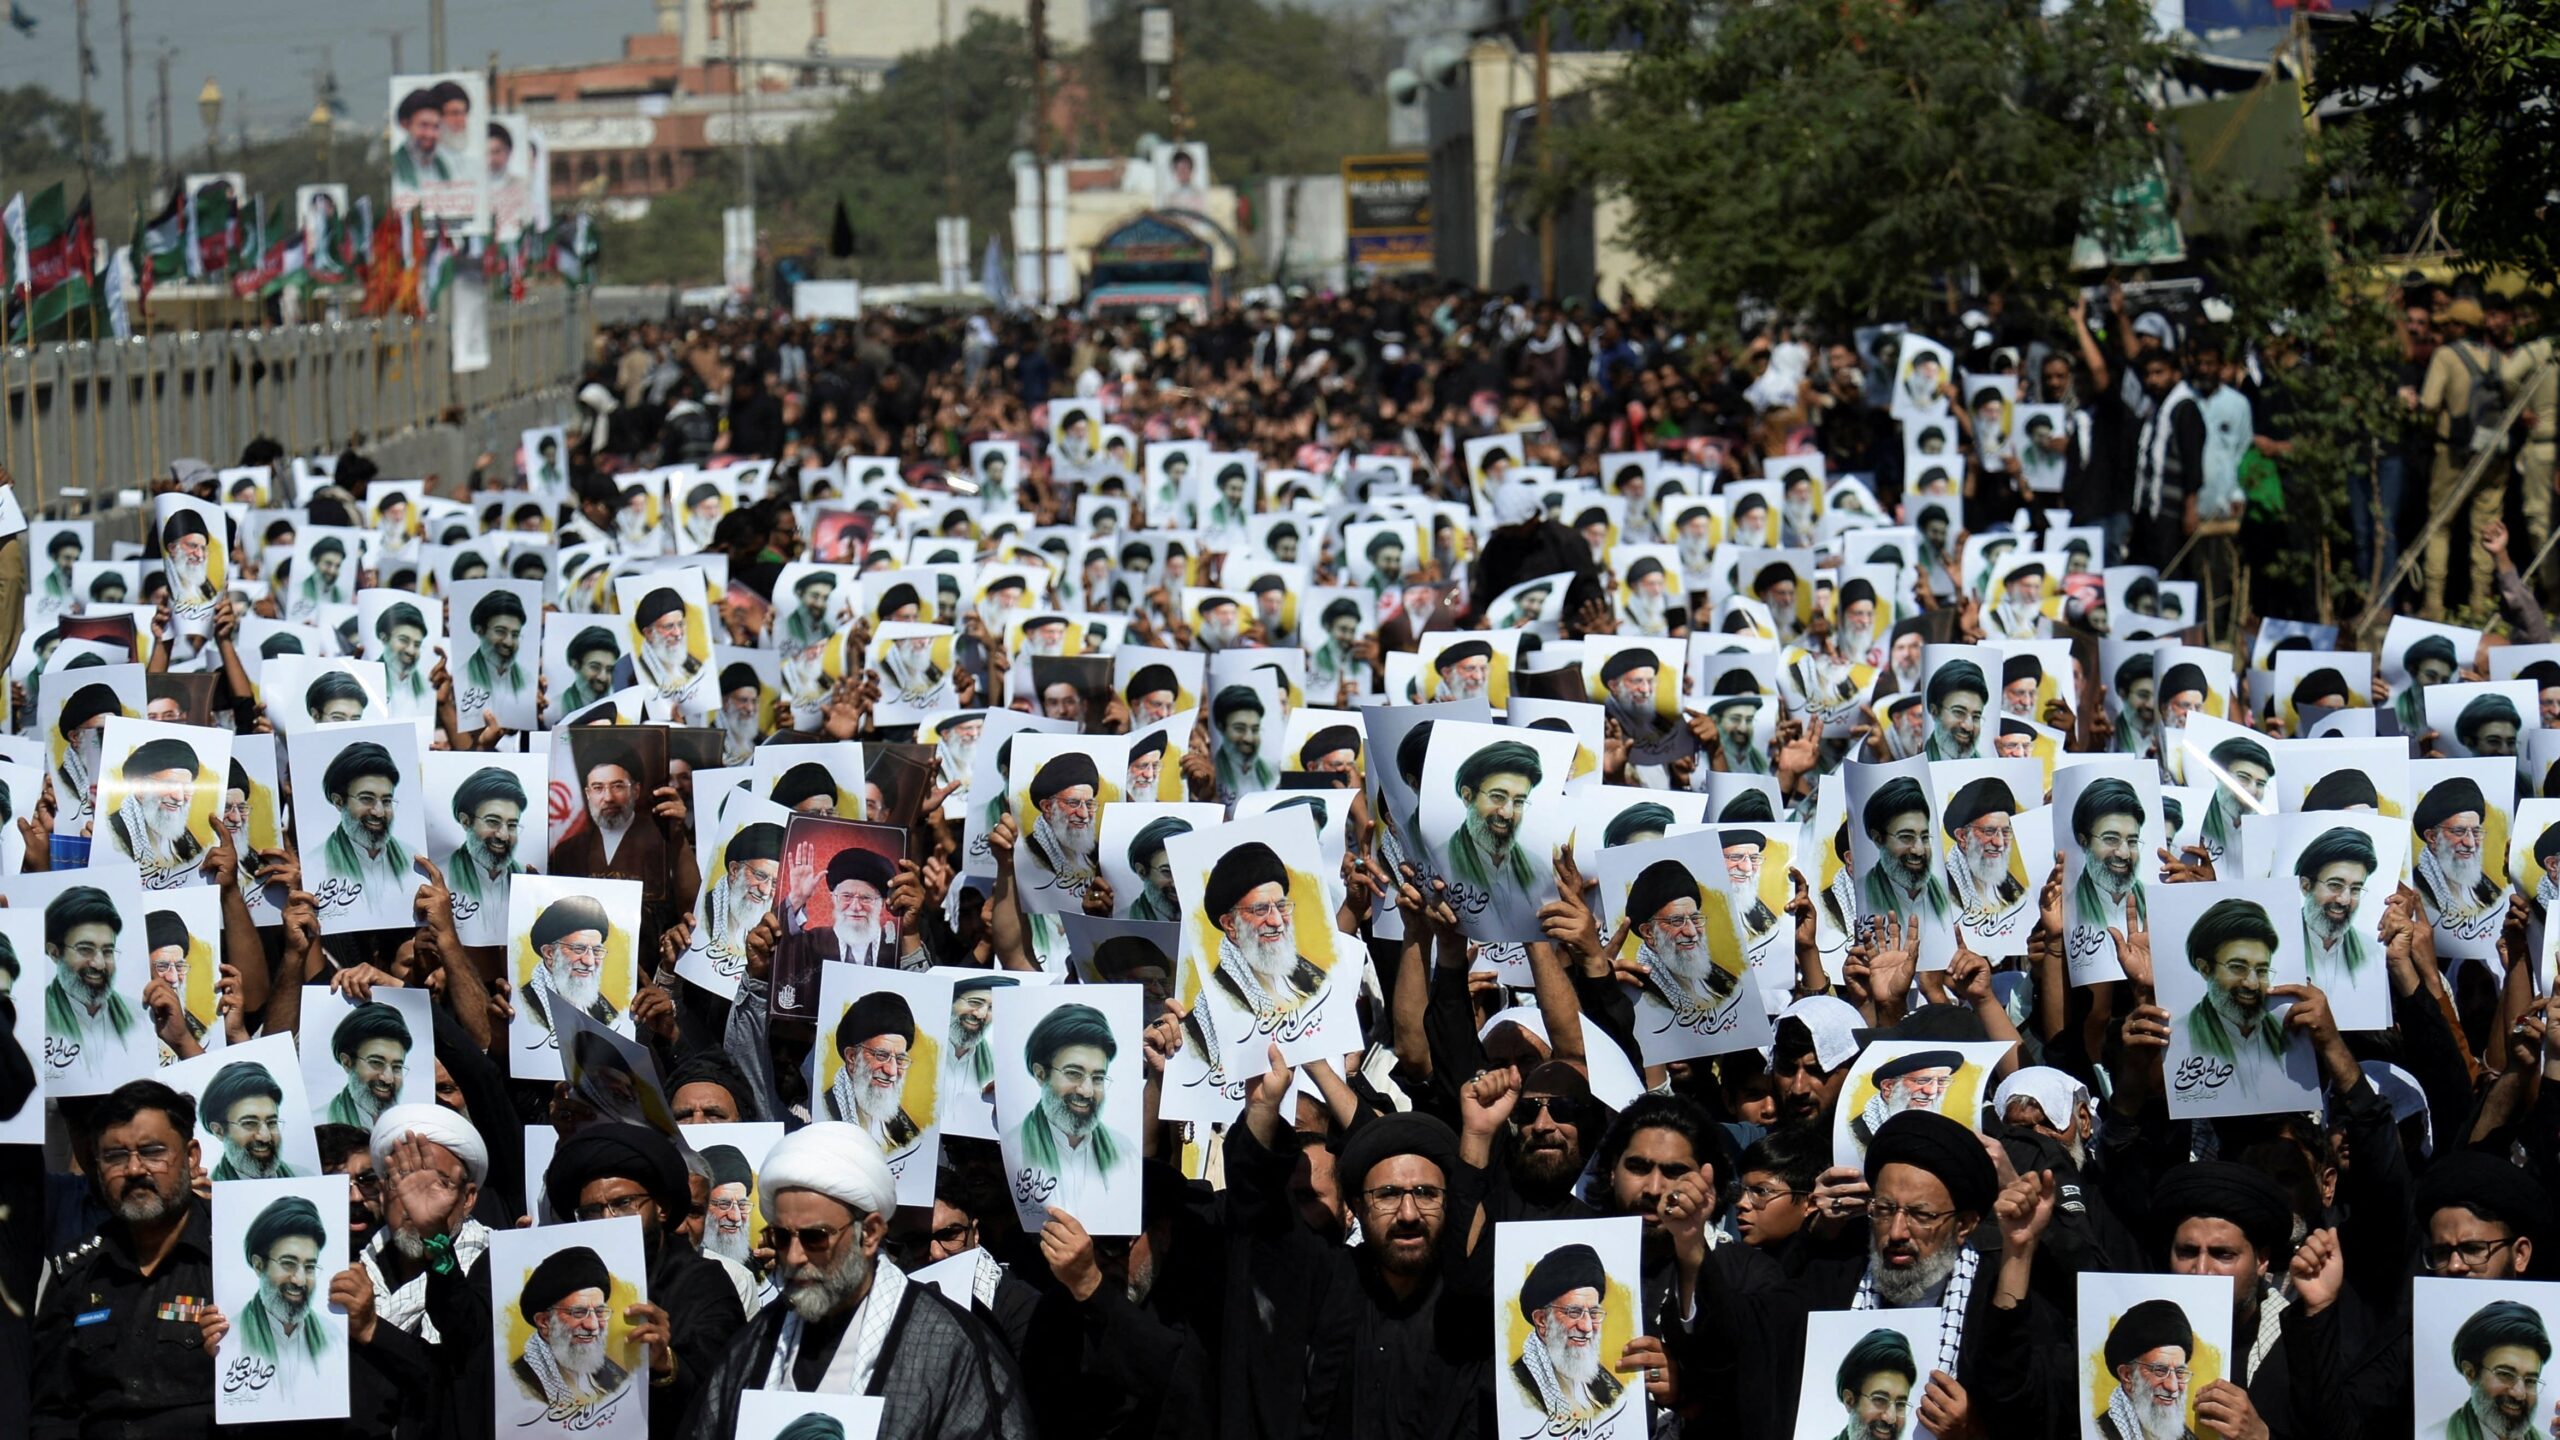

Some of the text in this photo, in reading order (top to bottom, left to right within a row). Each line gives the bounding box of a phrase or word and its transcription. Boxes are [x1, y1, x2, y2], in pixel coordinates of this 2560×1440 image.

[337, 878, 362, 906] صالح
[455, 895, 480, 920] صالح
[2085, 925, 2106, 956] صالح
[53, 1037, 81, 1068] صالح
[2174, 1055, 2234, 1091] صالح بعد صالح
[1016, 1167, 1033, 1204] صالح
[1033, 1168, 1057, 1203] صالح
[223, 1356, 276, 1393] صالح بعد صالح
